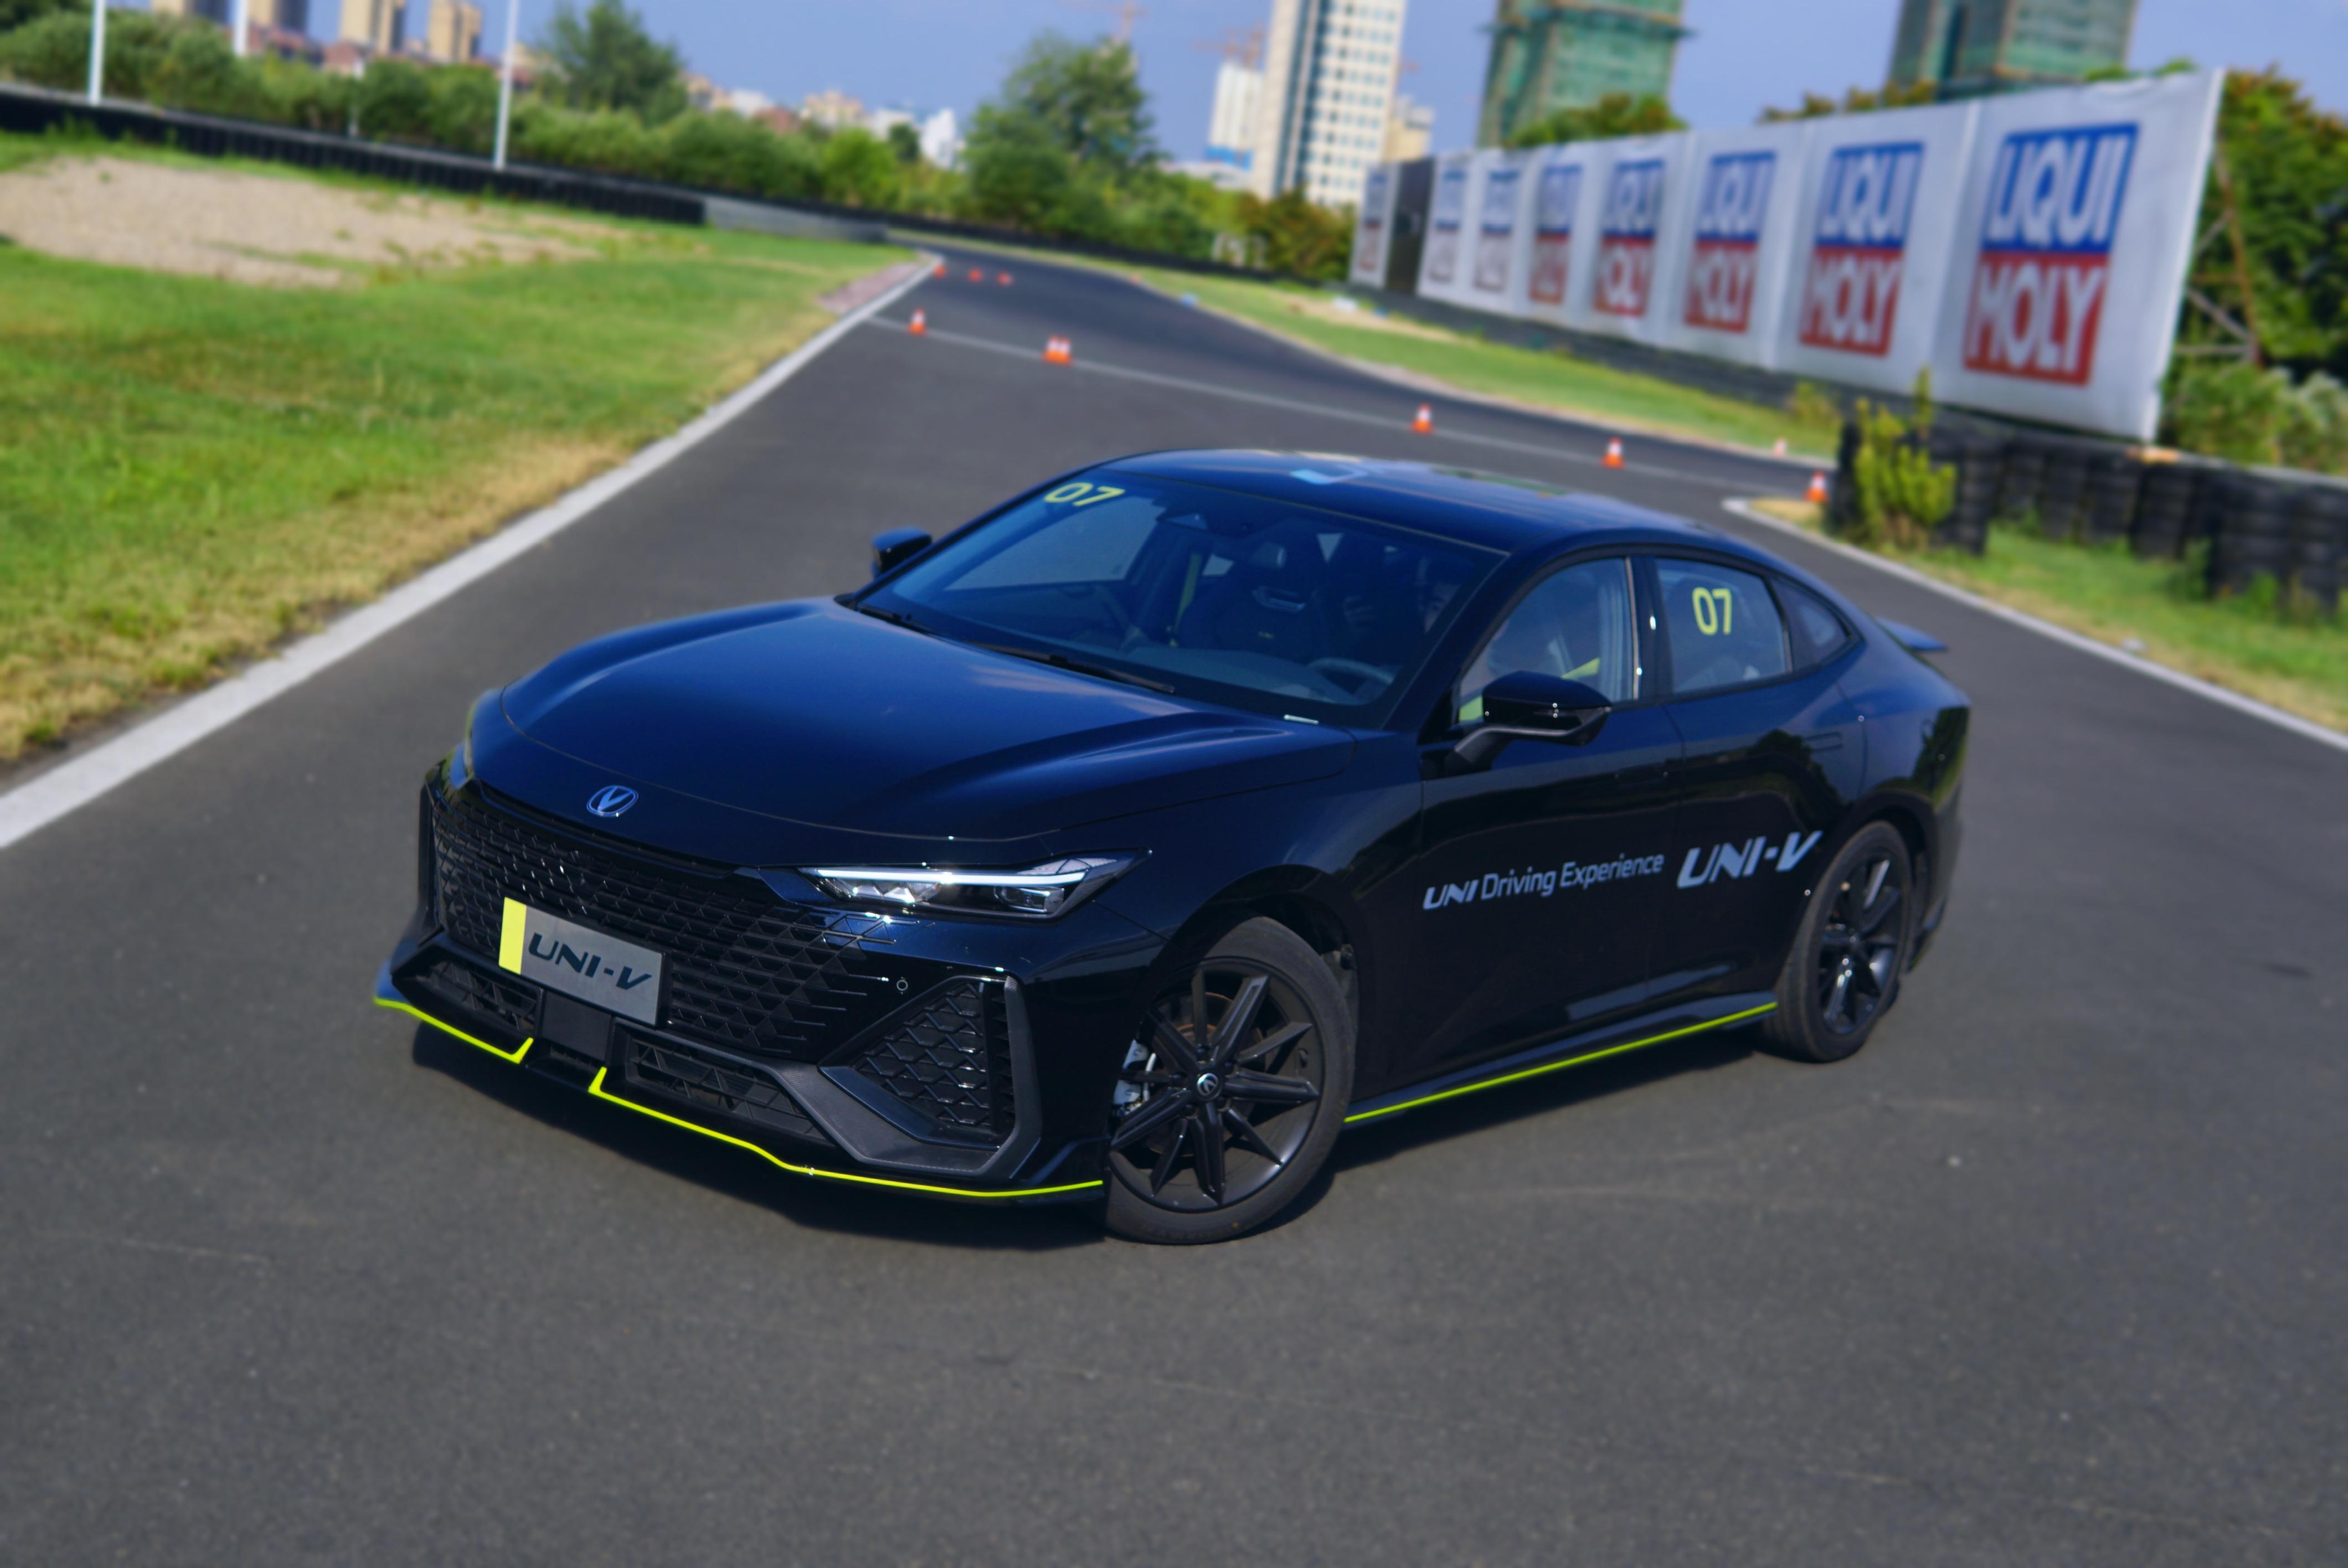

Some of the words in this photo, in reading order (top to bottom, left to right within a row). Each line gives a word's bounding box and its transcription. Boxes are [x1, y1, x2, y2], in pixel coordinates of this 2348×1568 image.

[1987, 134, 2130, 246] LIQUI
[1965, 261, 2106, 374] MOLY
[1043, 482, 1126, 507] 07
[1692, 587, 1732, 636] 07
[1423, 879, 1480, 910] UNI
[1480, 865, 1558, 898] Driving
[1559, 853, 1665, 890] Experience
[1676, 830, 1823, 889] UNI-V
[528, 932, 653, 991] UNI-V
